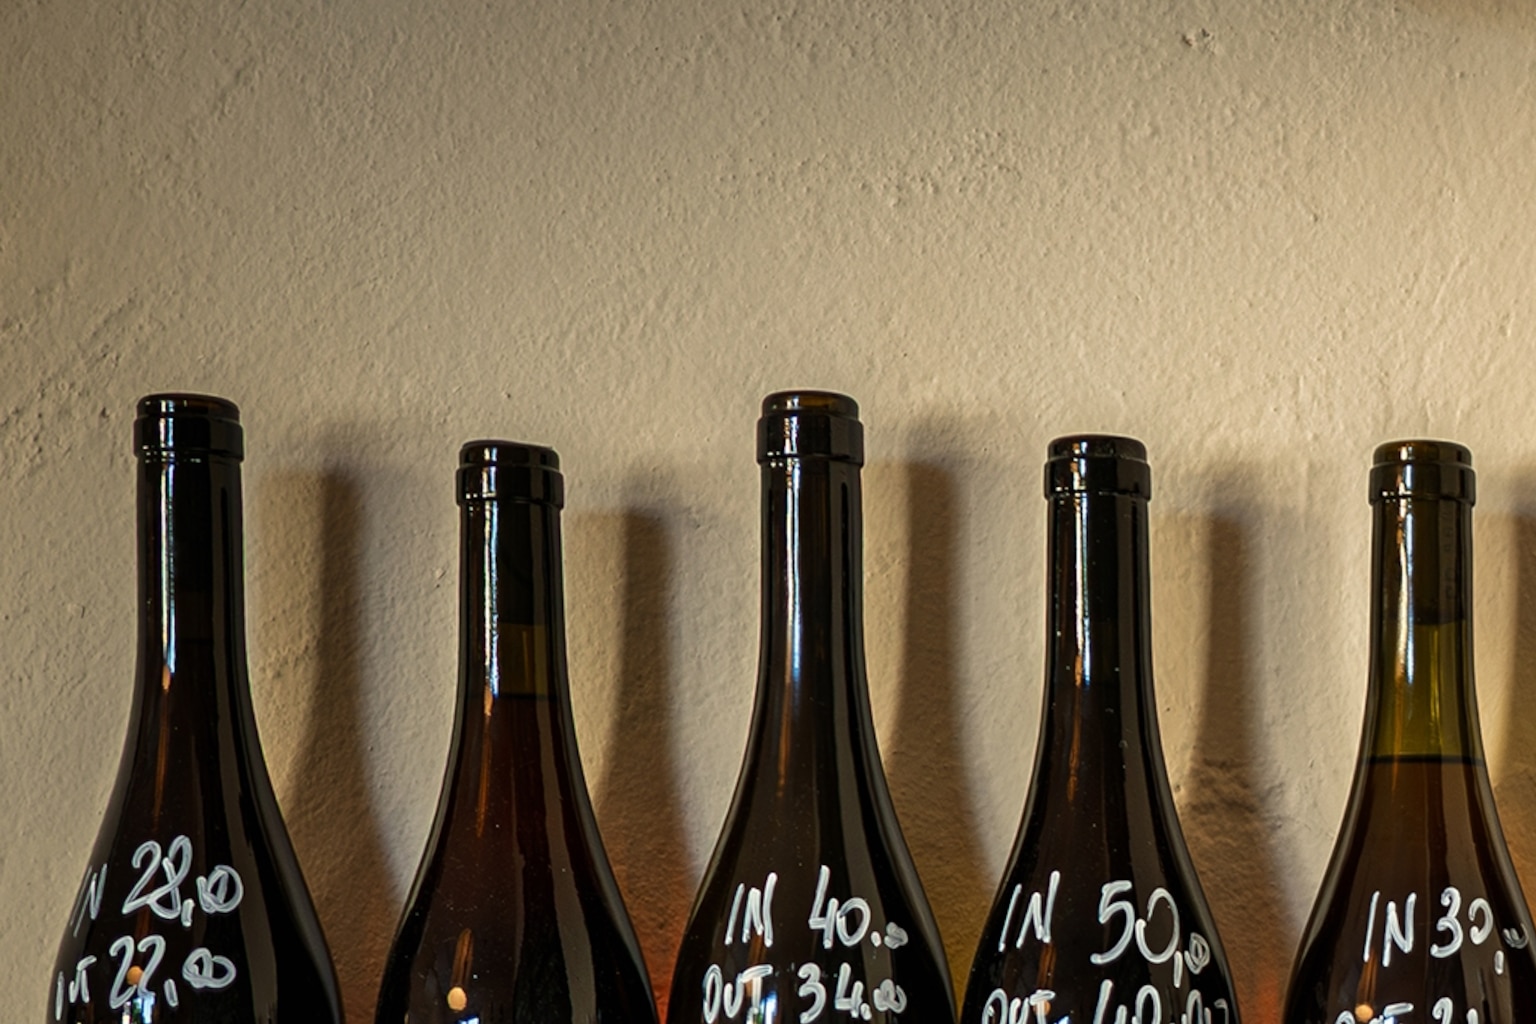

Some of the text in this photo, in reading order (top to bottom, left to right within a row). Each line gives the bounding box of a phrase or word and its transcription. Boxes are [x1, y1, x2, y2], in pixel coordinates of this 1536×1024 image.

[724, 872, 778, 948] IN
[998, 870, 1061, 952] IN
[1363, 890, 1417, 968] IN
[702, 963, 774, 1024] OUT
